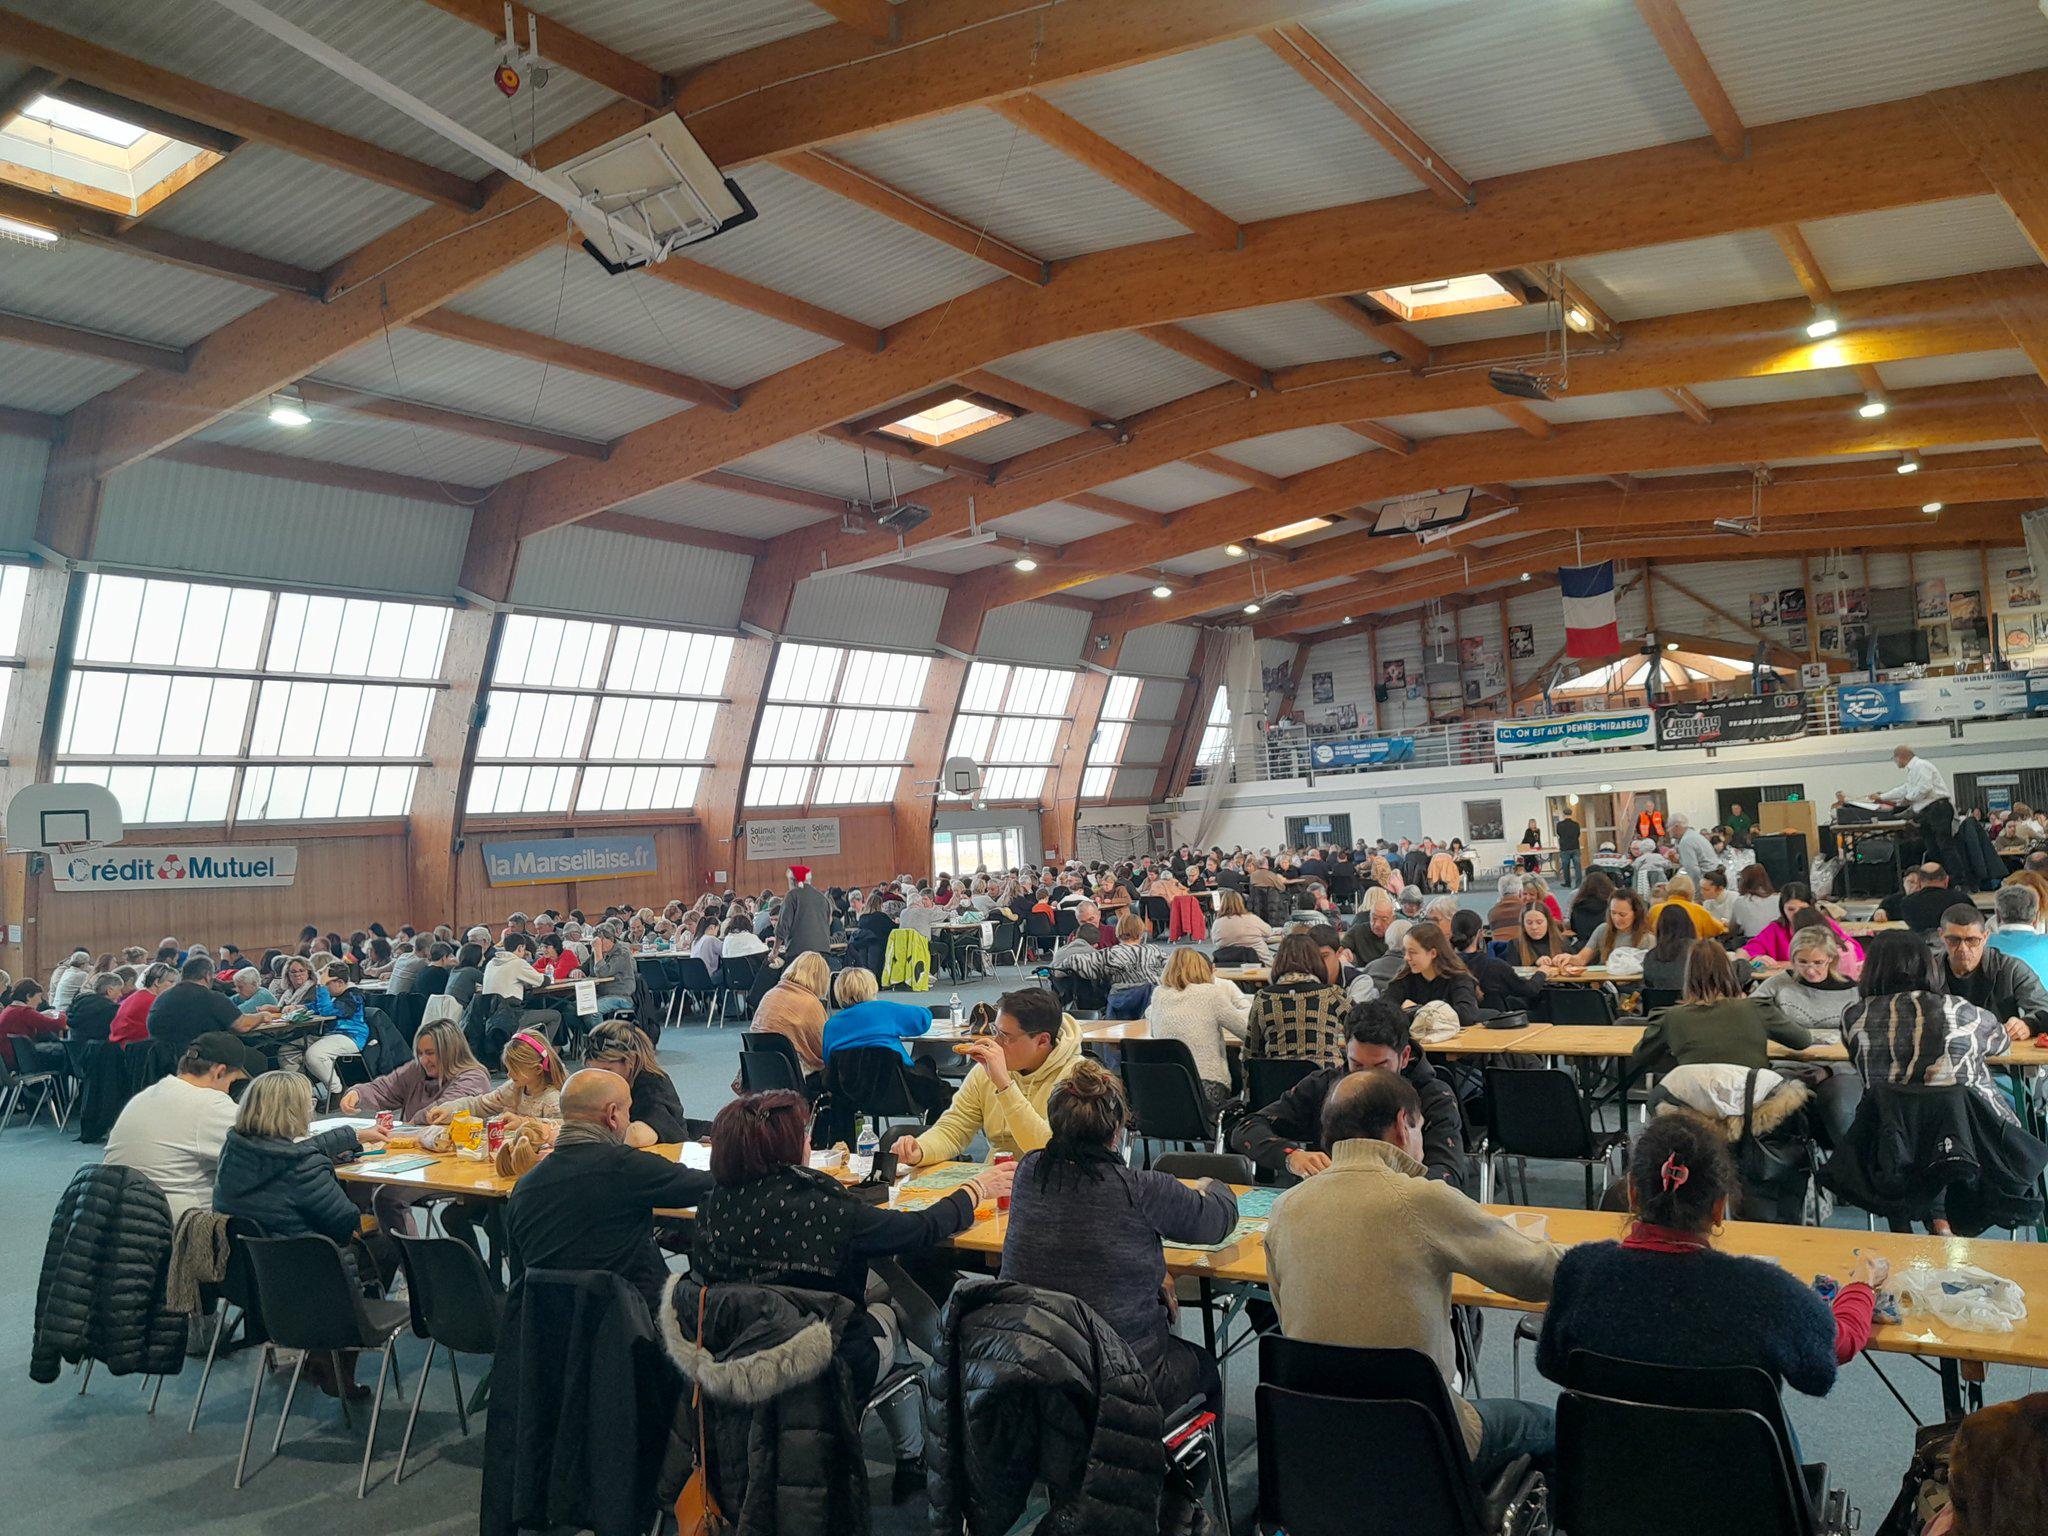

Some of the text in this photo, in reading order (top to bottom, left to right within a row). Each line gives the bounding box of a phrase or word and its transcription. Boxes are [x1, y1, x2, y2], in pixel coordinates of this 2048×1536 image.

[1516, 729, 1530, 738] ON
[1532, 728, 1546, 737] EST
[1547, 726, 1564, 735] AUX
[750, 826, 776, 835] Solimut
[782, 824, 806, 834] Solimut
[513, 845, 649, 875] Marseillaise.fr
[189, 856, 274, 878] Mutuel
